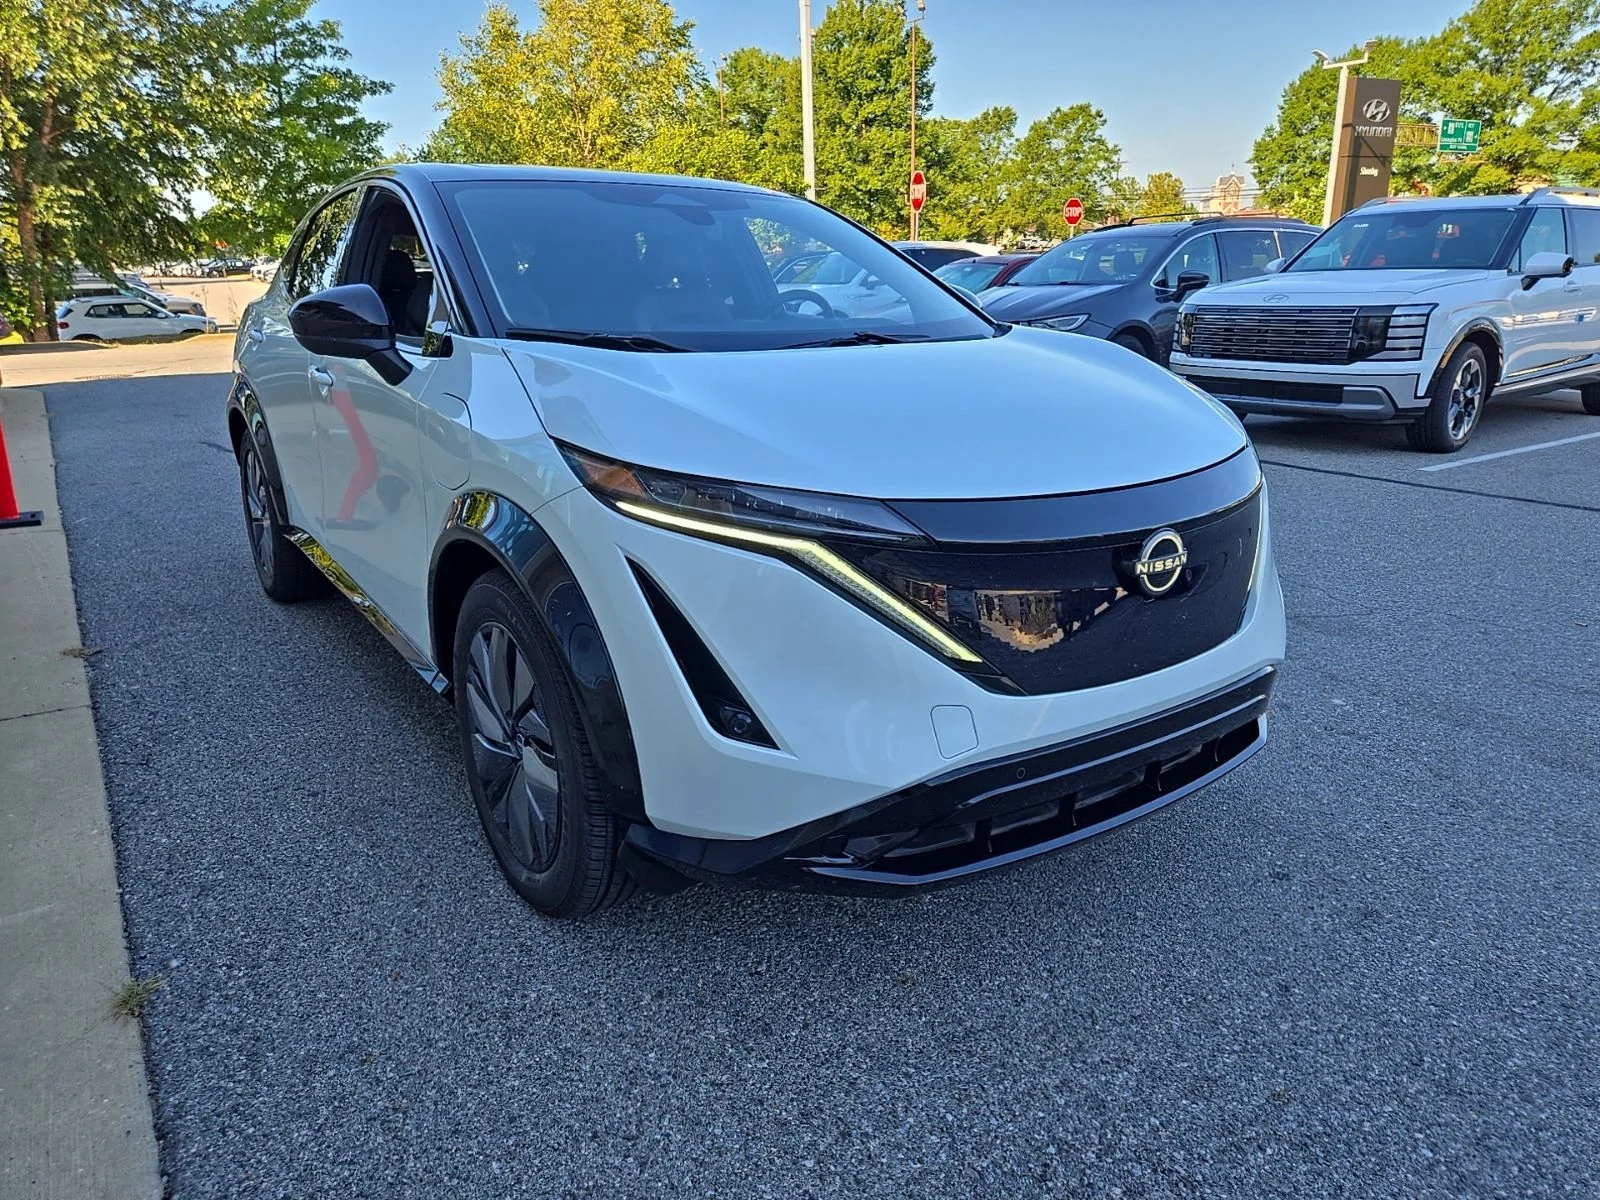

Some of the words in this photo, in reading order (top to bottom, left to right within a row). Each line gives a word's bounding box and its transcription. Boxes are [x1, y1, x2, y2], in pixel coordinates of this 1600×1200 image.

[1355, 126, 1392, 137] HYUNDAI
[911, 183, 925, 200] STOP
[1065, 206, 1082, 218] STOP
[1136, 553, 1187, 574] NISSAN
